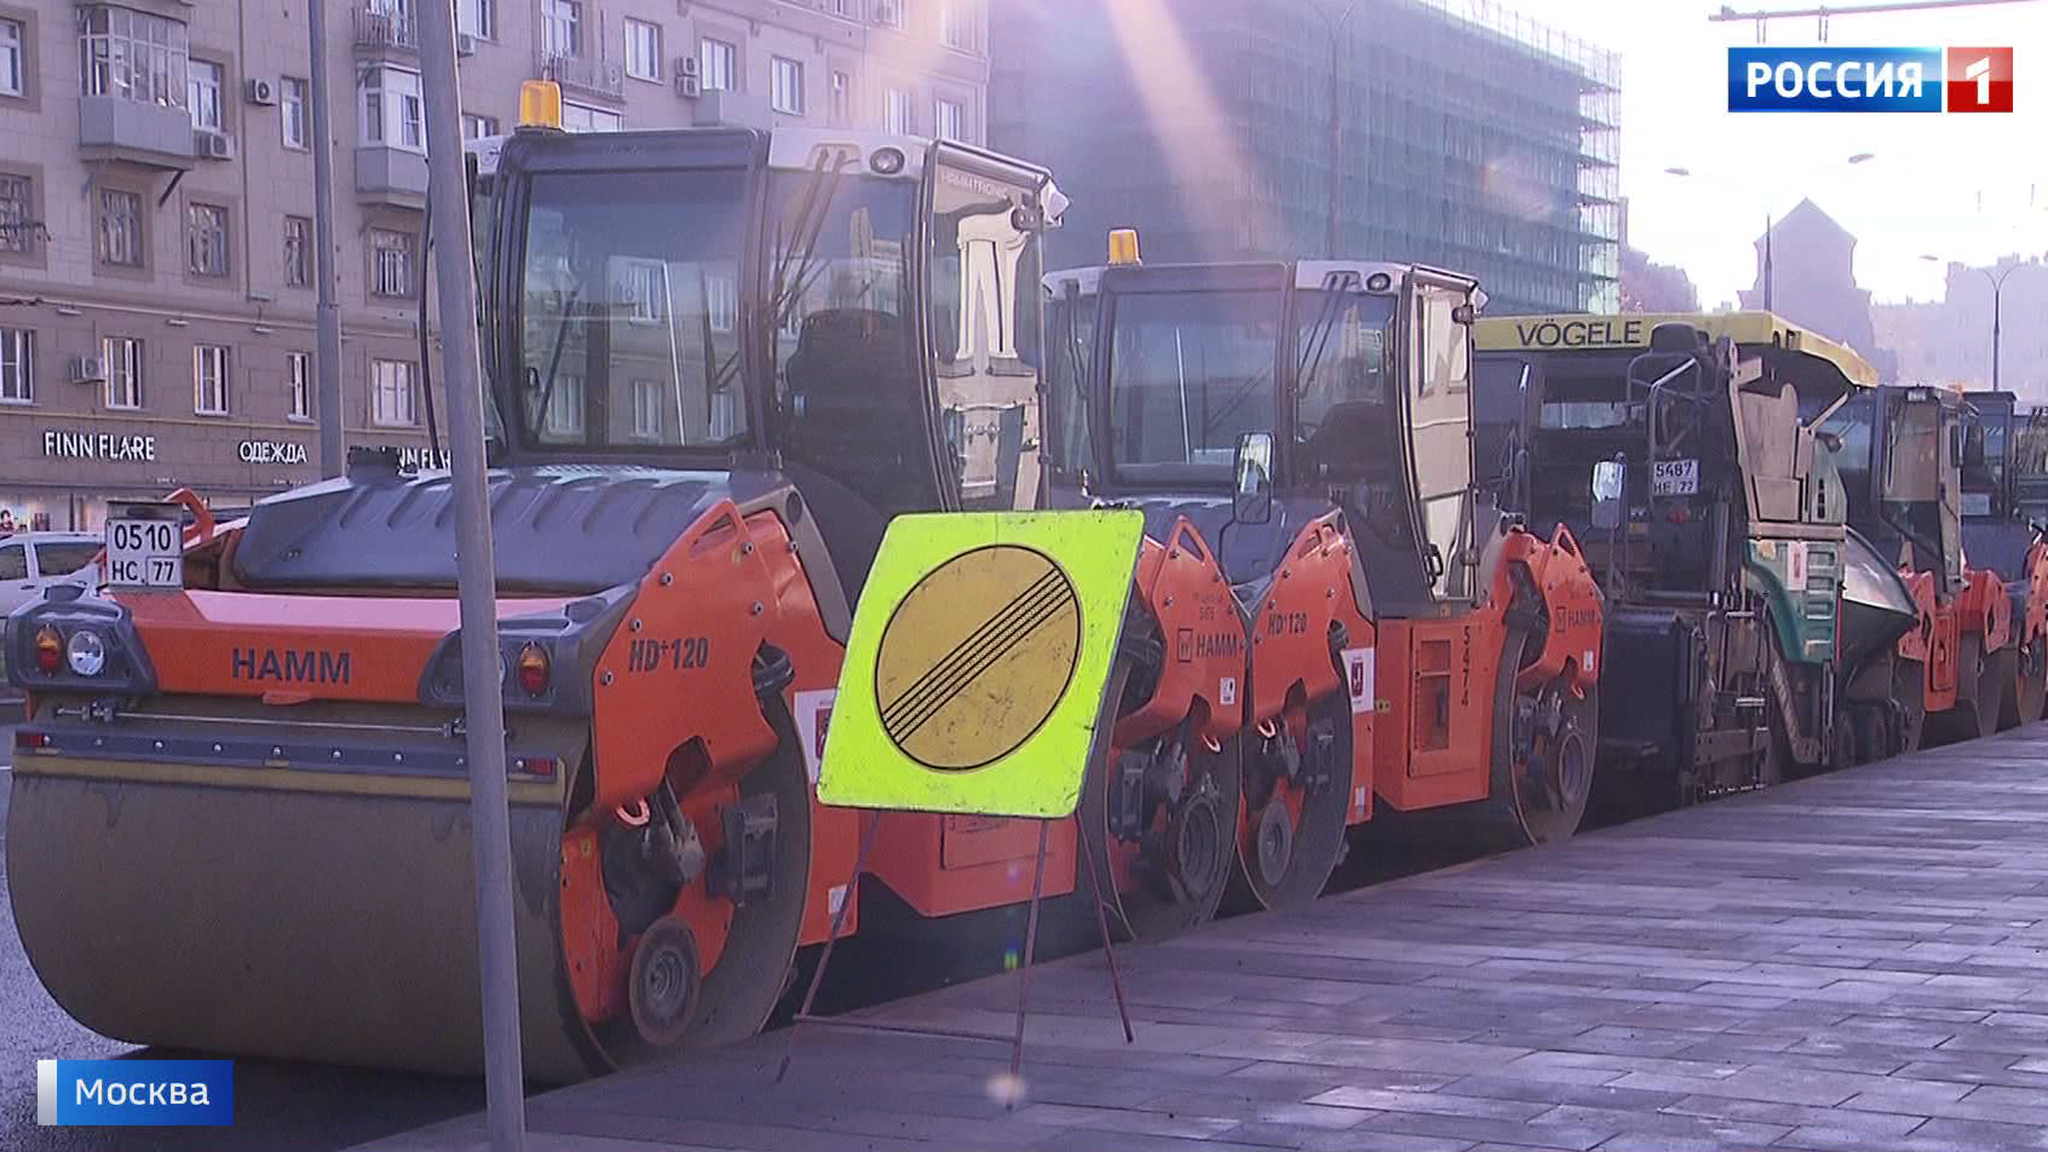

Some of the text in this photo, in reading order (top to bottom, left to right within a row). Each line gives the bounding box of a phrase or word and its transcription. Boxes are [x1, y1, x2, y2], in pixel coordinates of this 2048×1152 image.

[1517, 318, 1642, 346] VÖGELE
[44, 431, 155, 460] FINN FLARE
[239, 441, 308, 463] ОДЕЖДА
[1656, 462, 1692, 477] 5487
[114, 524, 171, 551] 0510
[112, 561, 174, 581] НС 77
[1196, 633, 1238, 657] HAMM
[232, 647, 350, 684] HAMM
